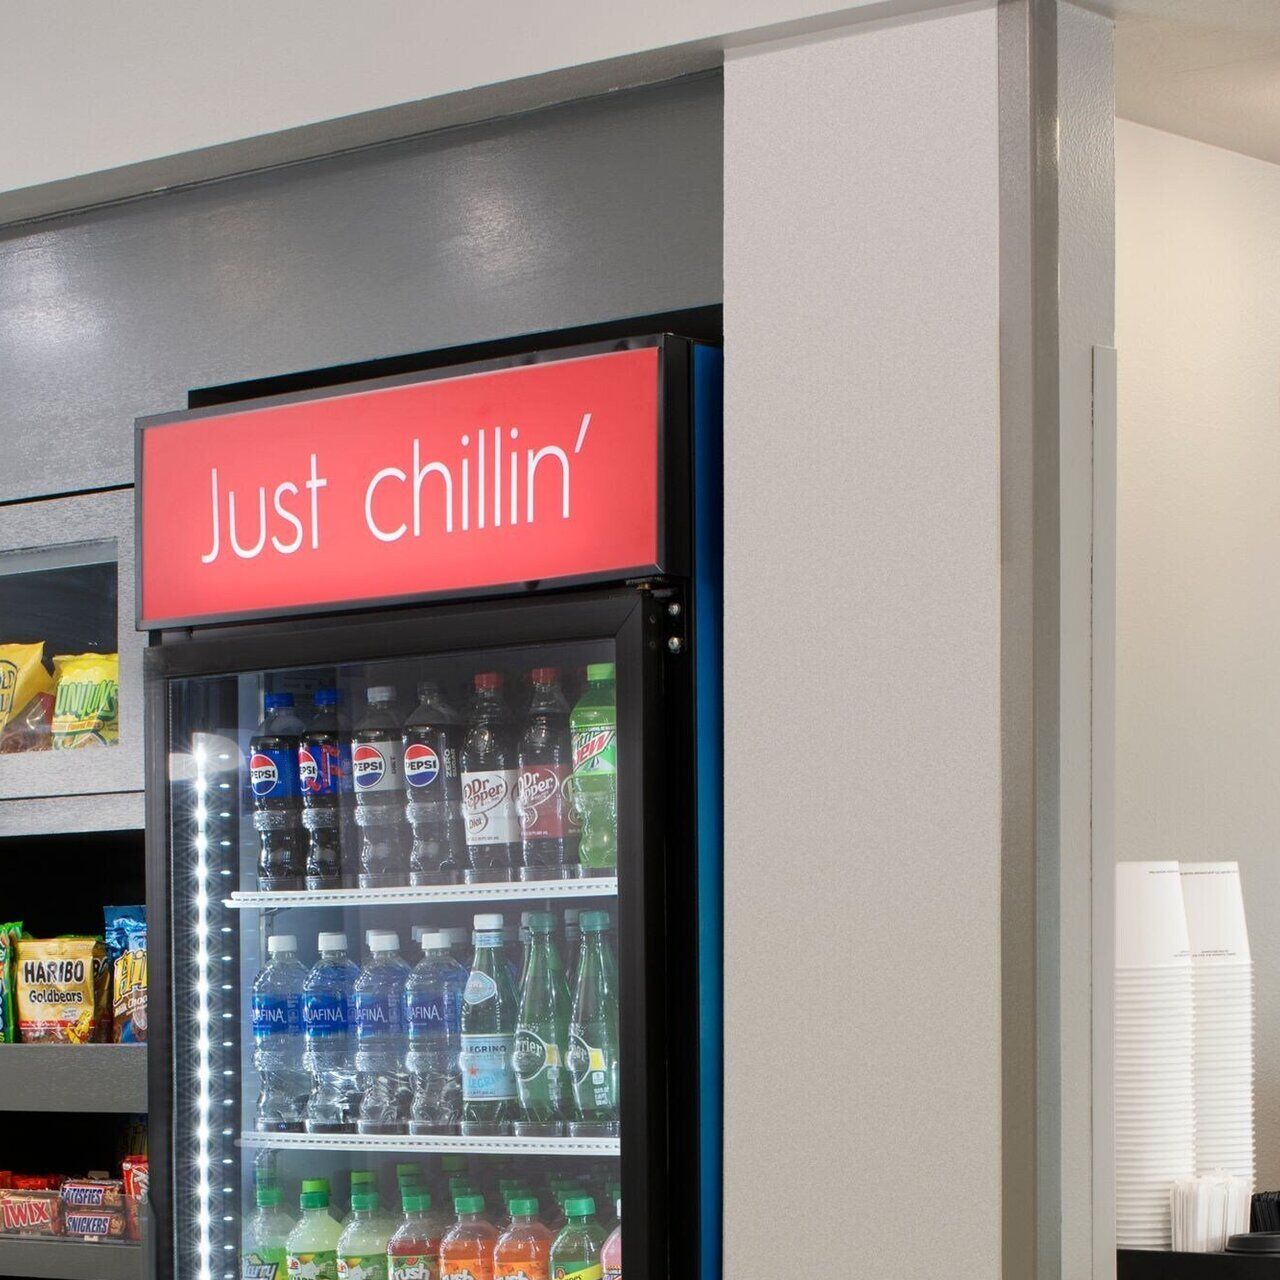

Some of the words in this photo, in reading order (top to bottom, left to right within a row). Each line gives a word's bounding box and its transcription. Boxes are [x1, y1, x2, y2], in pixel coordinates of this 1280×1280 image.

[201, 453, 327, 564] Just
[443, 749, 451, 777] ZERO
[24, 960, 83, 983] HARIBO
[29, 990, 83, 1004] Goldbears
[1, 1199, 50, 1229] TWIX
[67, 1215, 109, 1234] SNICKERS
